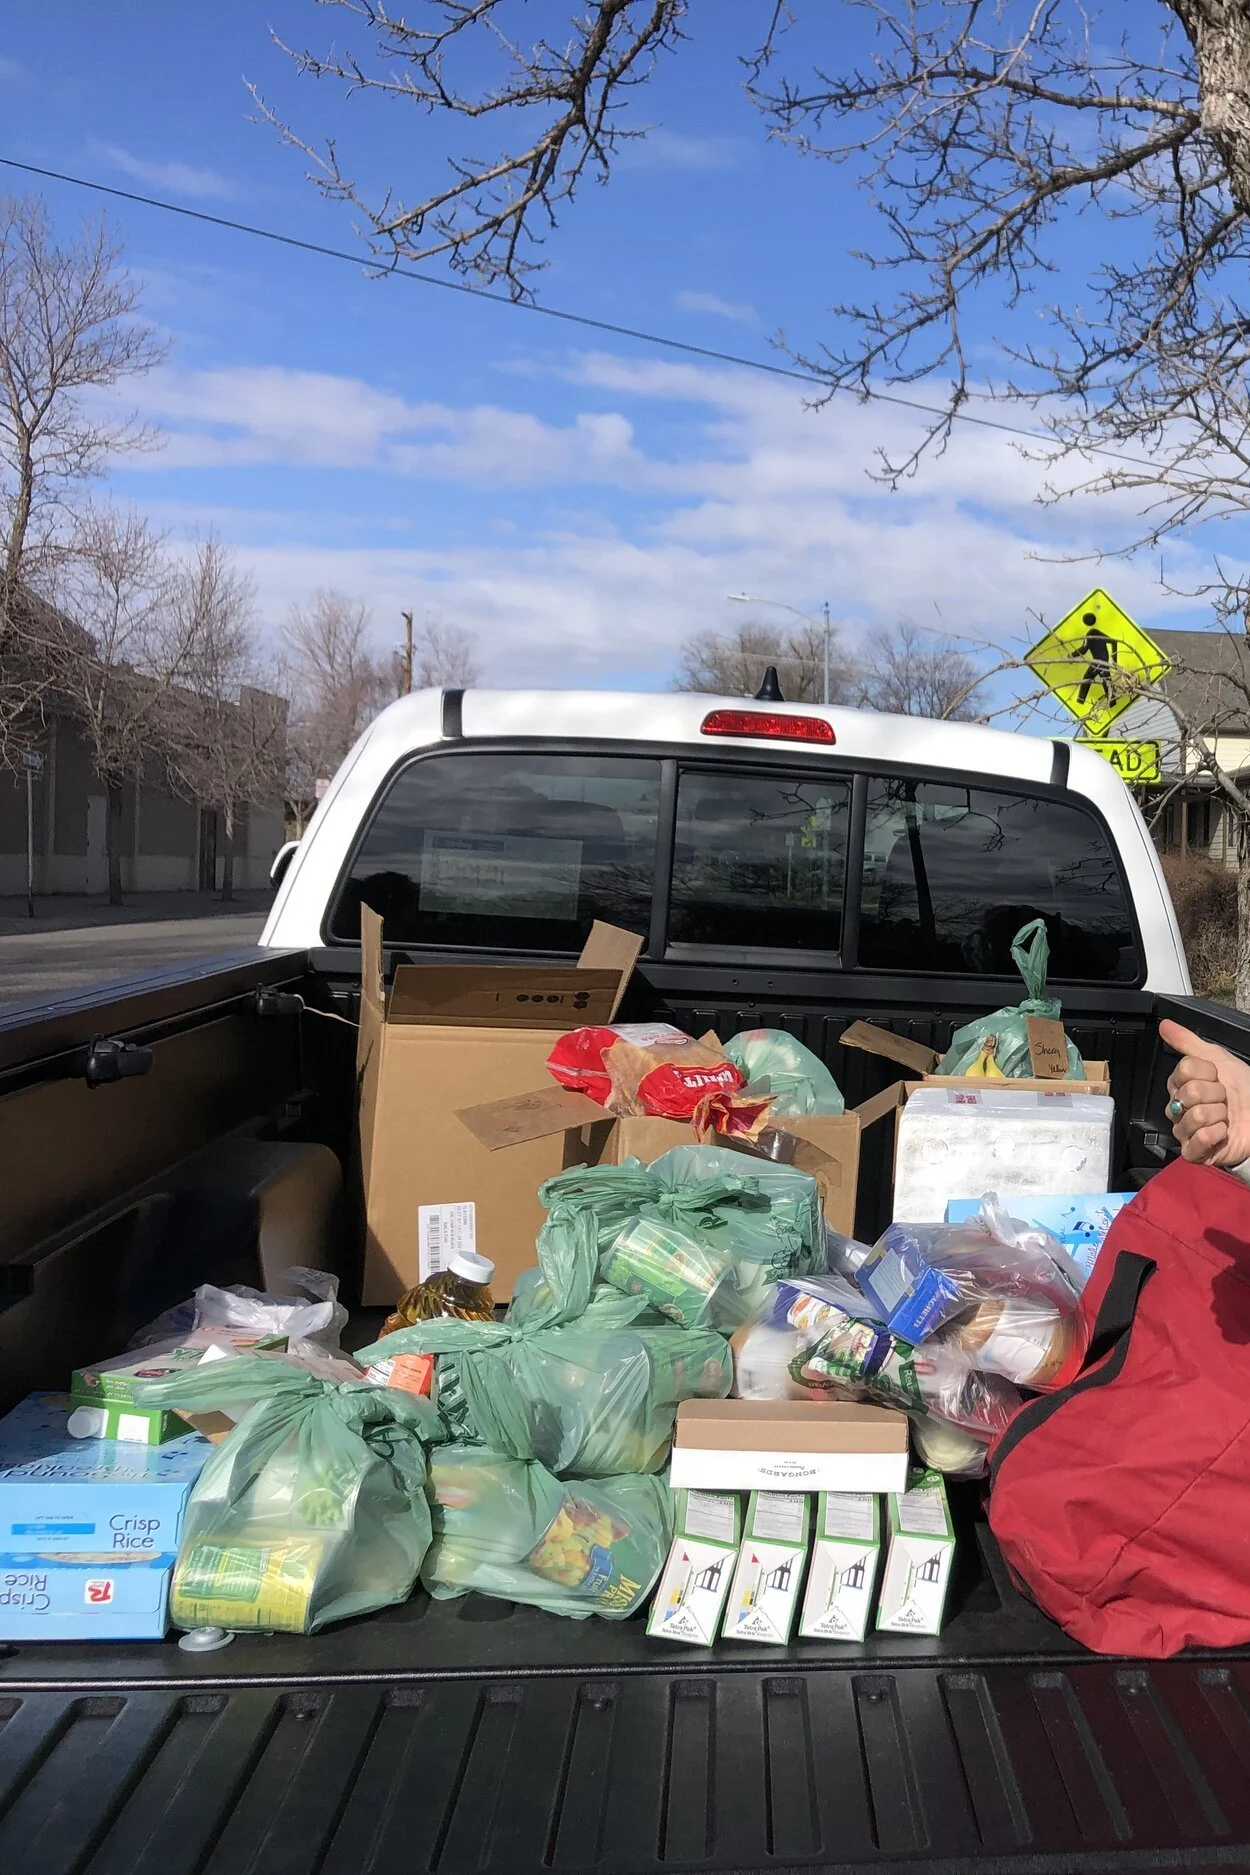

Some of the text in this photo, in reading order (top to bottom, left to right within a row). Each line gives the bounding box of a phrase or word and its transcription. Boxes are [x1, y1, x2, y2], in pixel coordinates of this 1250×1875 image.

[109, 1514, 160, 1536] Crisp
[112, 1532, 154, 1549] Rice
[4, 1573, 48, 1592] Rice
[0, 1588, 50, 1611] Crisp
